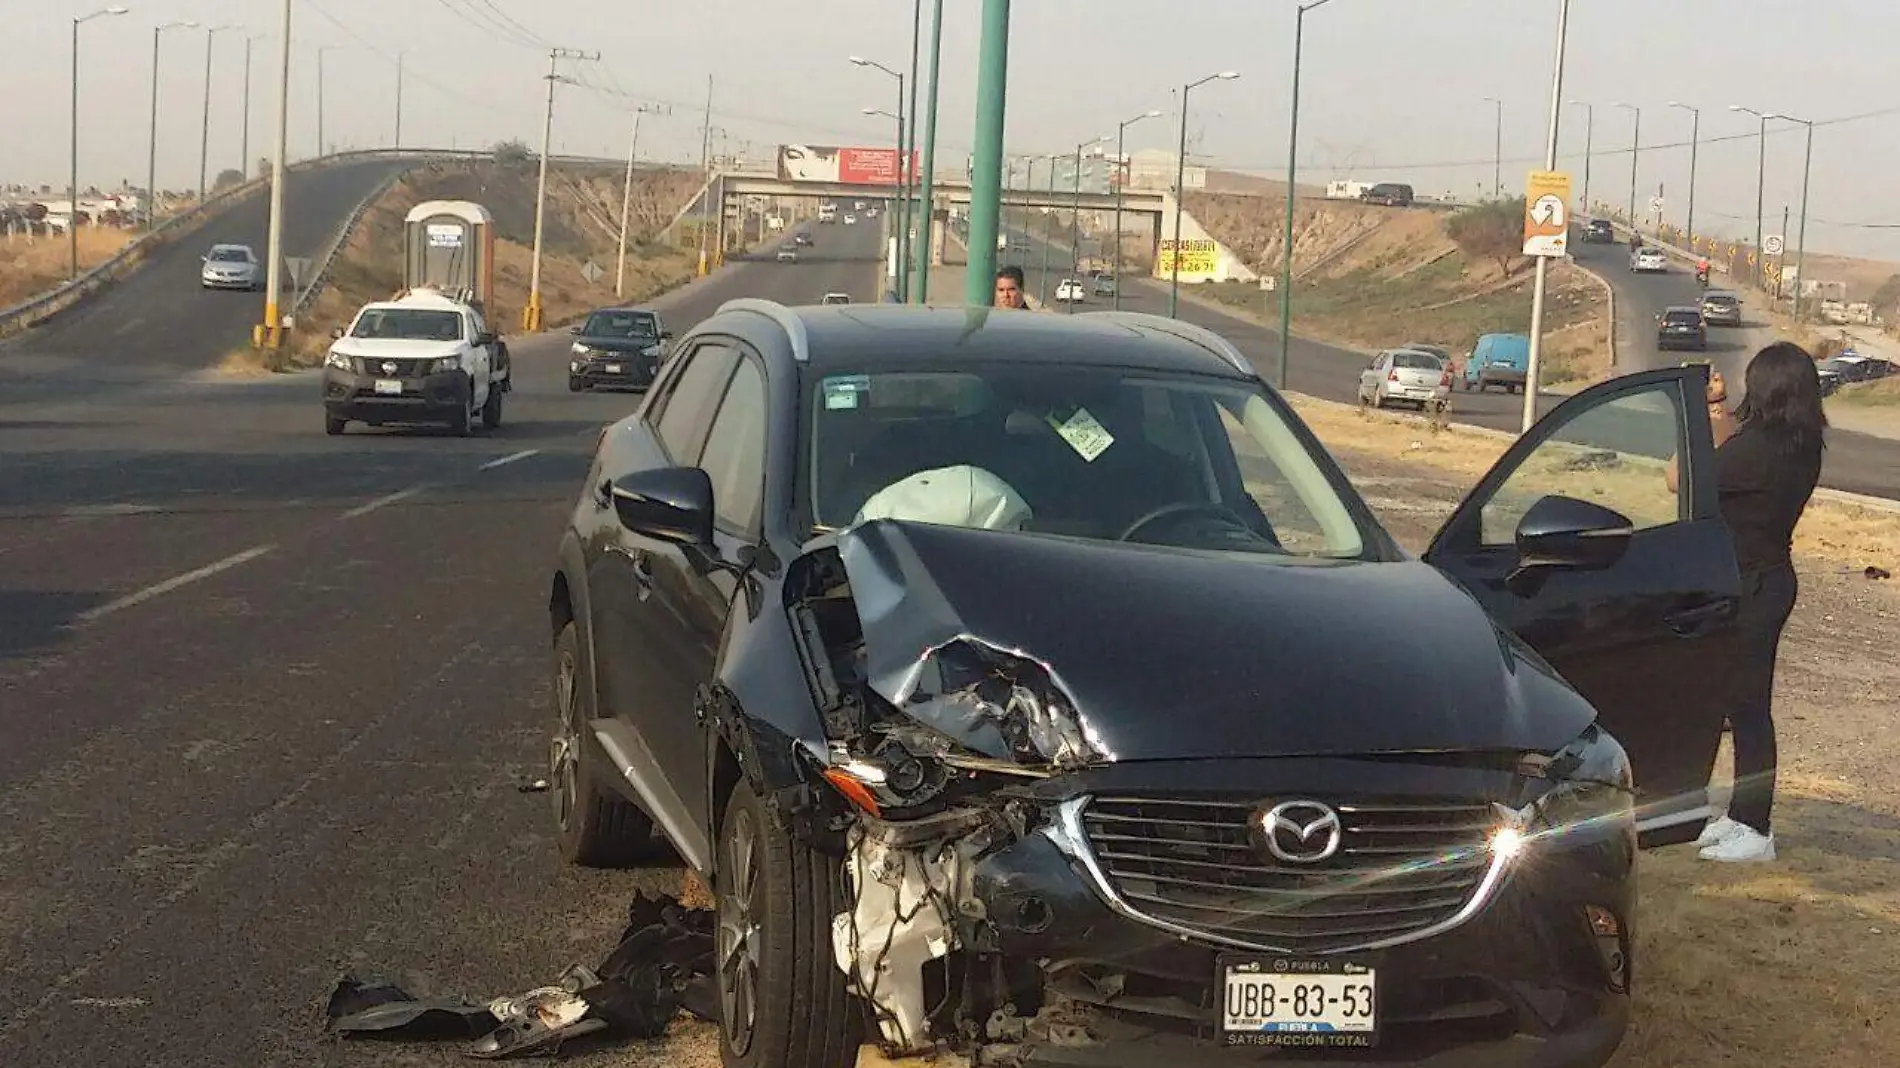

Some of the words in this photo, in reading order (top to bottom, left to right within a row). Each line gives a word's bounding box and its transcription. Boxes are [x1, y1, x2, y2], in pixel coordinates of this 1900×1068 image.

[1290, 961, 1330, 971] PUEBLA
[1228, 983, 1373, 1017] UBB-83-53
[1228, 1034, 1324, 1045] SATISFACCIÓN
[1328, 1035, 1369, 1046] TOTAL
